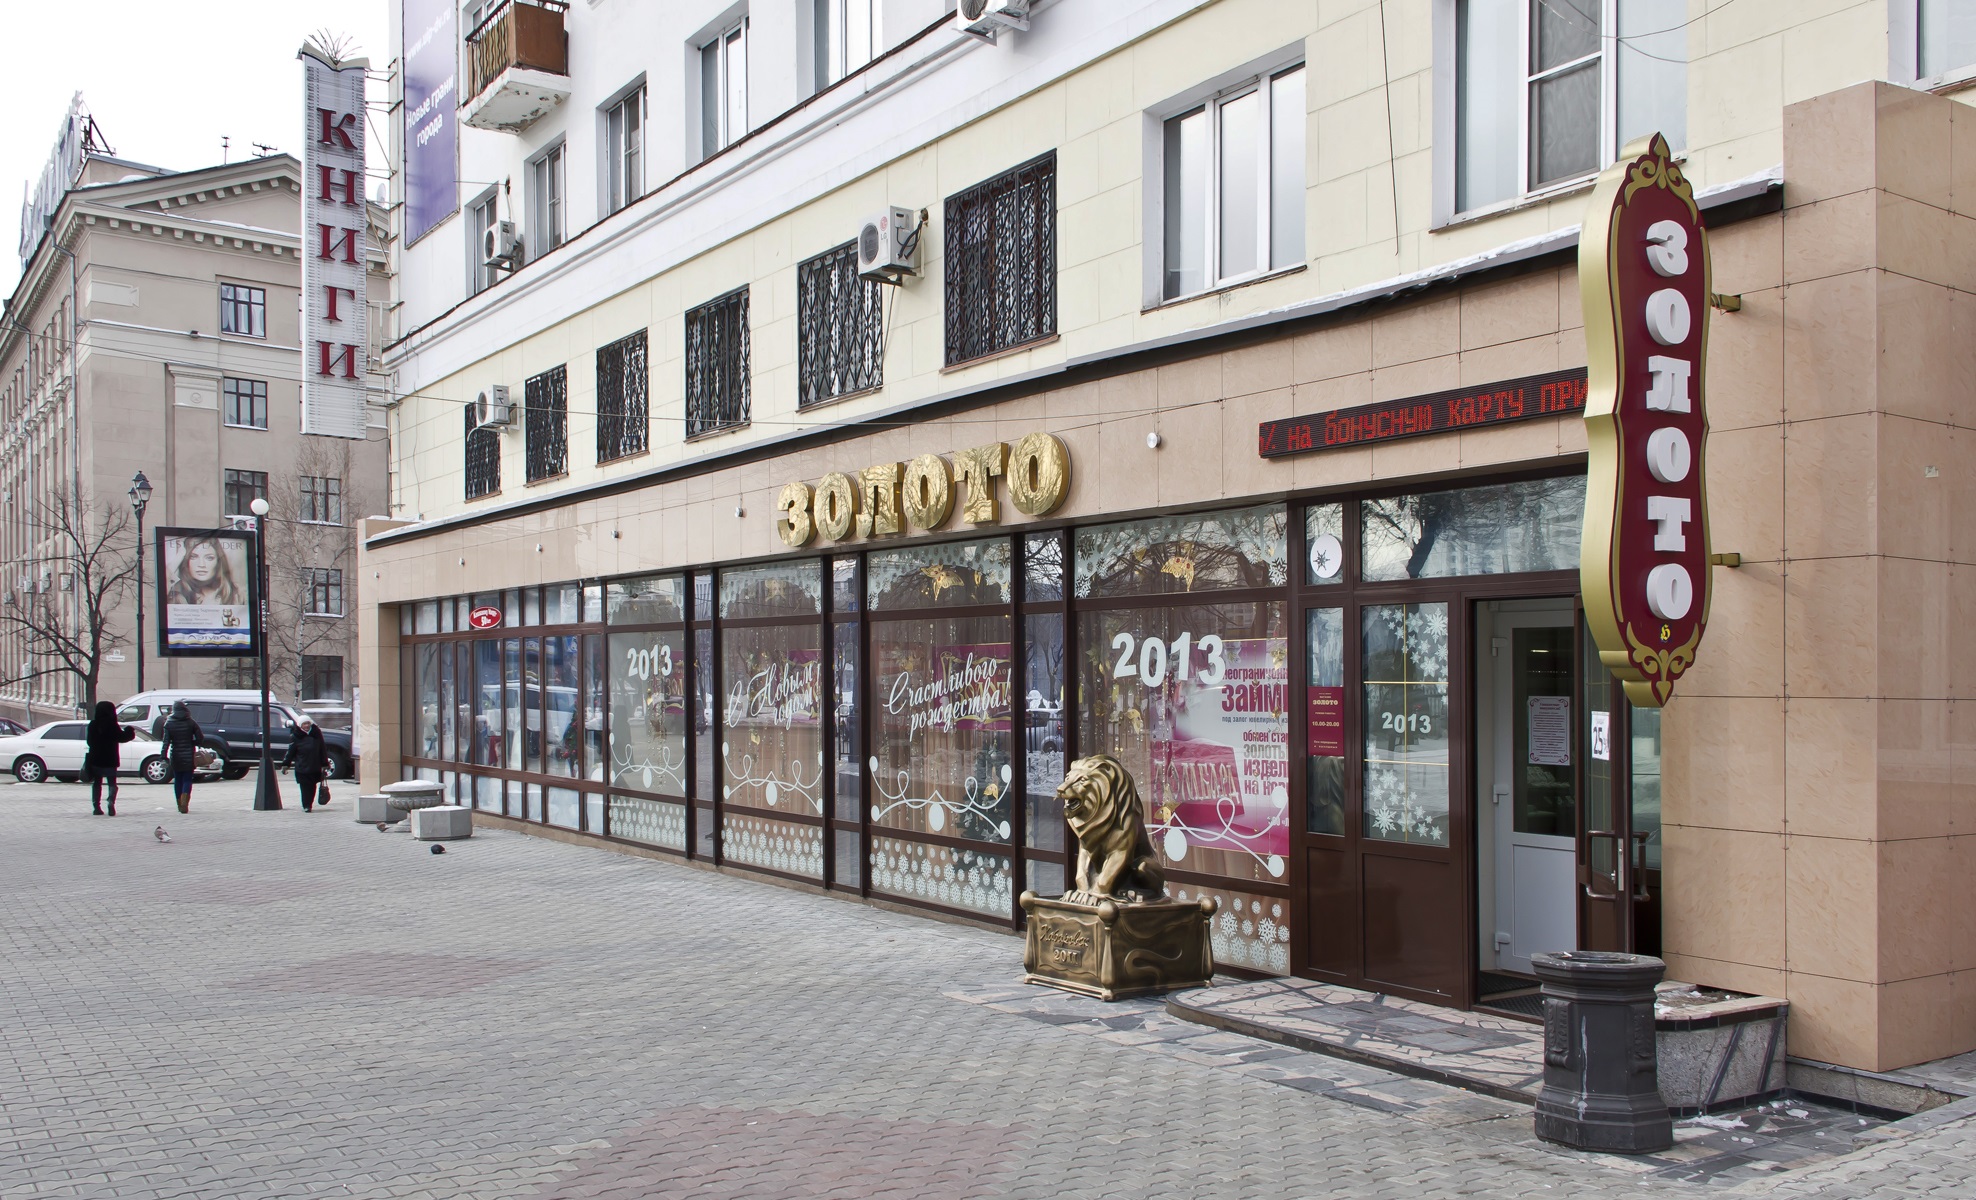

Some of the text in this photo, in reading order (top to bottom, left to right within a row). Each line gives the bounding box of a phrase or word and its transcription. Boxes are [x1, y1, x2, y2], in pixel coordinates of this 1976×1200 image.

[406, 74, 454, 131] Новые грани
[416, 113, 443, 147] города
[316, 107, 360, 379] КНИГИ
[1287, 426, 1312, 450] на
[1645, 219, 1693, 620] ЗОЛОТО
[777, 432, 1071, 547] ЗОЛОТО
[627, 644, 673, 680] 2013
[882, 652, 998, 714] Счастливого
[1112, 631, 1226, 688] 2013
[723, 663, 813, 728] С Новым
[1381, 711, 1432, 733] 2013
